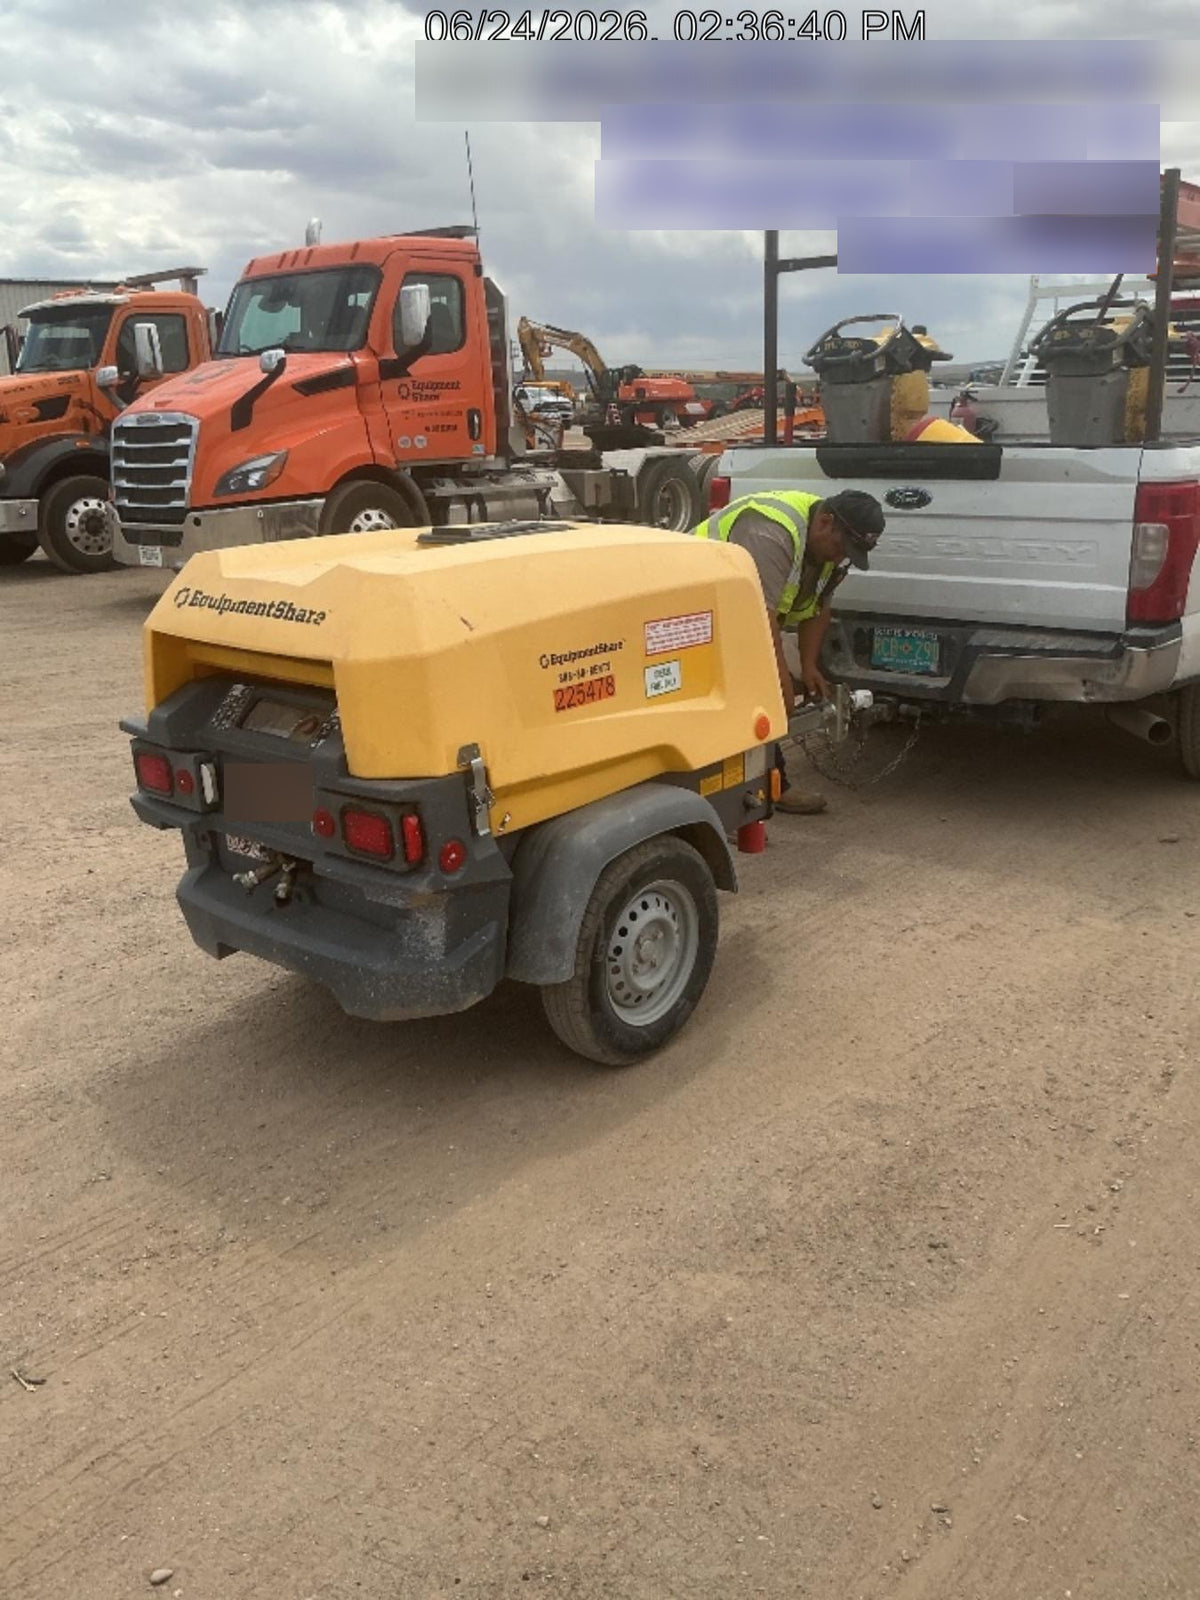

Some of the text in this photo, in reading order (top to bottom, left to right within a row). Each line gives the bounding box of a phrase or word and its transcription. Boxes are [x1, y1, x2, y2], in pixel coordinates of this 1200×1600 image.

[412, 380, 461, 391] Equipment
[188, 590, 326, 626] EquipmentShare
[550, 641, 623, 666] EquipmentShare
[554, 674, 616, 713] 225478
